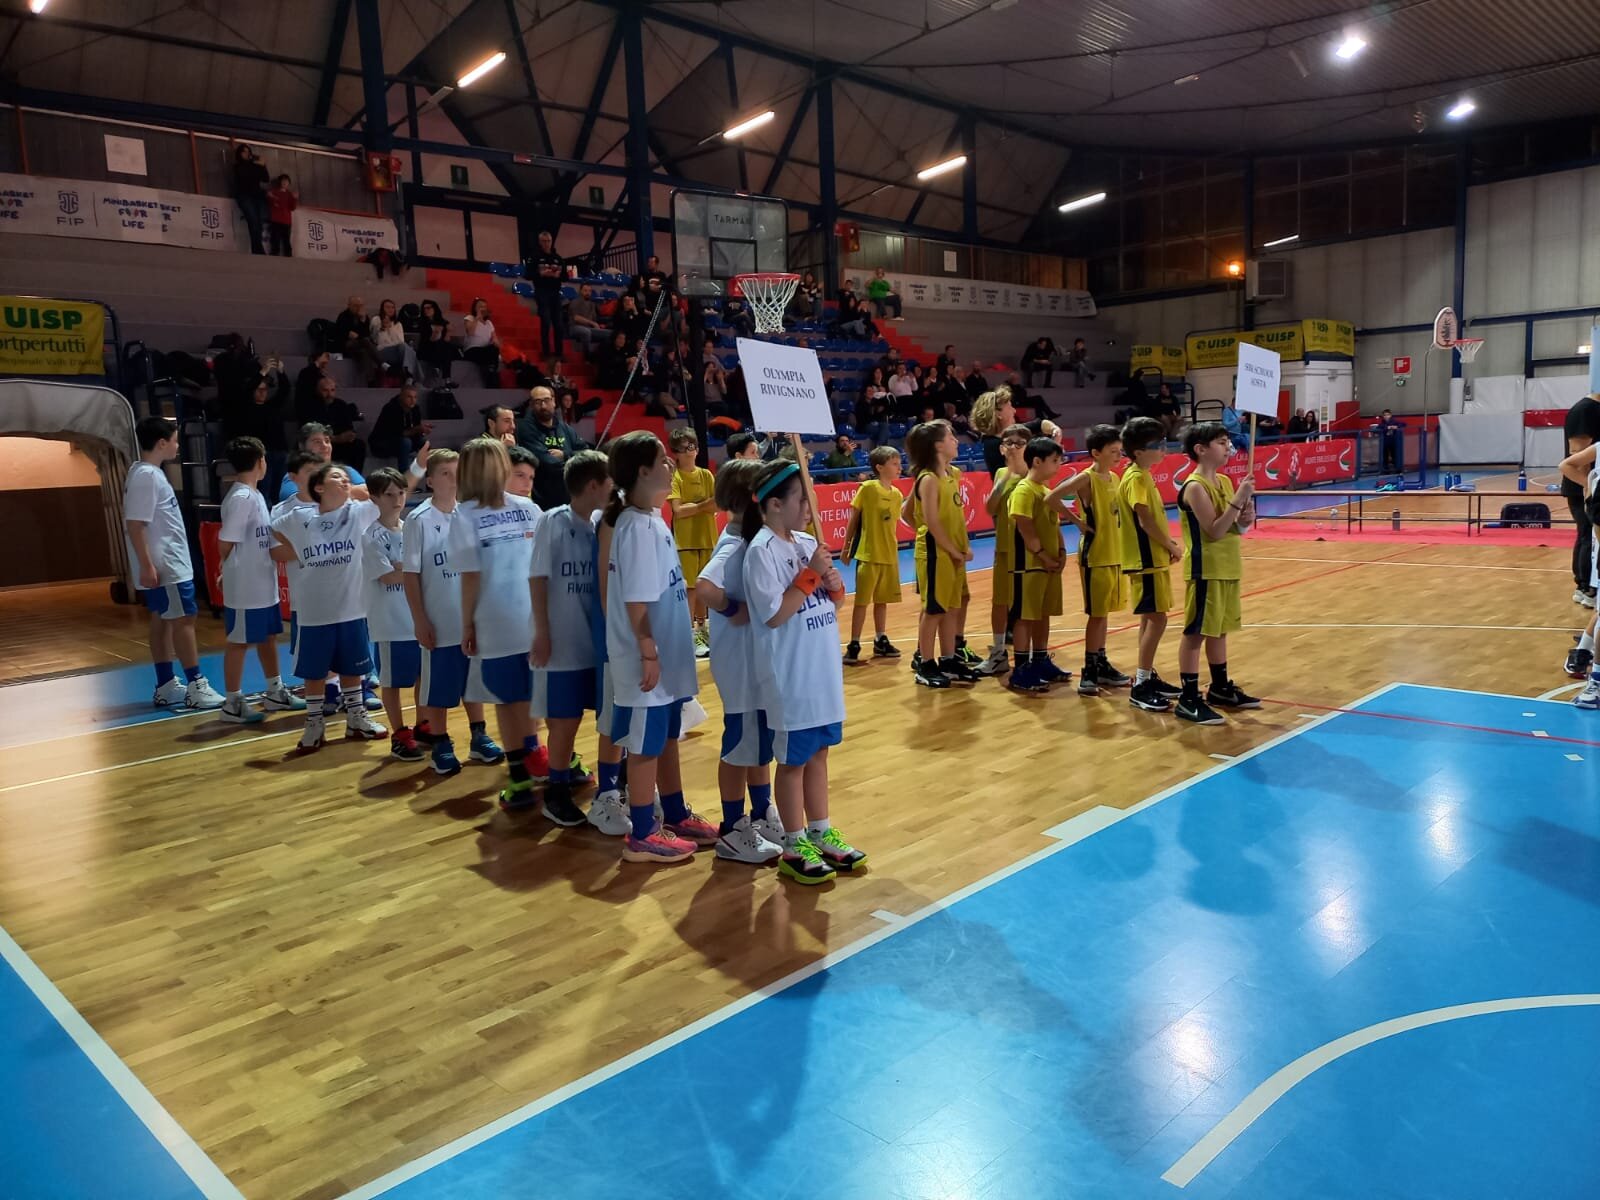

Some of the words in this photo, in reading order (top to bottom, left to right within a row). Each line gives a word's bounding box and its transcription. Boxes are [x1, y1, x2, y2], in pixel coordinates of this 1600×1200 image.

[56, 216, 84, 226] FIP
[122, 219, 145, 230] LIFE
[200, 230, 225, 240] FIP
[307, 242, 329, 252] FIP
[4, 306, 82, 330] UISP
[1207, 337, 1236, 349] UISP
[1266, 331, 1295, 343] UISP
[763, 367, 806, 383] OLYMPIA
[760, 383, 816, 399] RIVIGNANO
[303, 539, 356, 560] OLYMPIA
